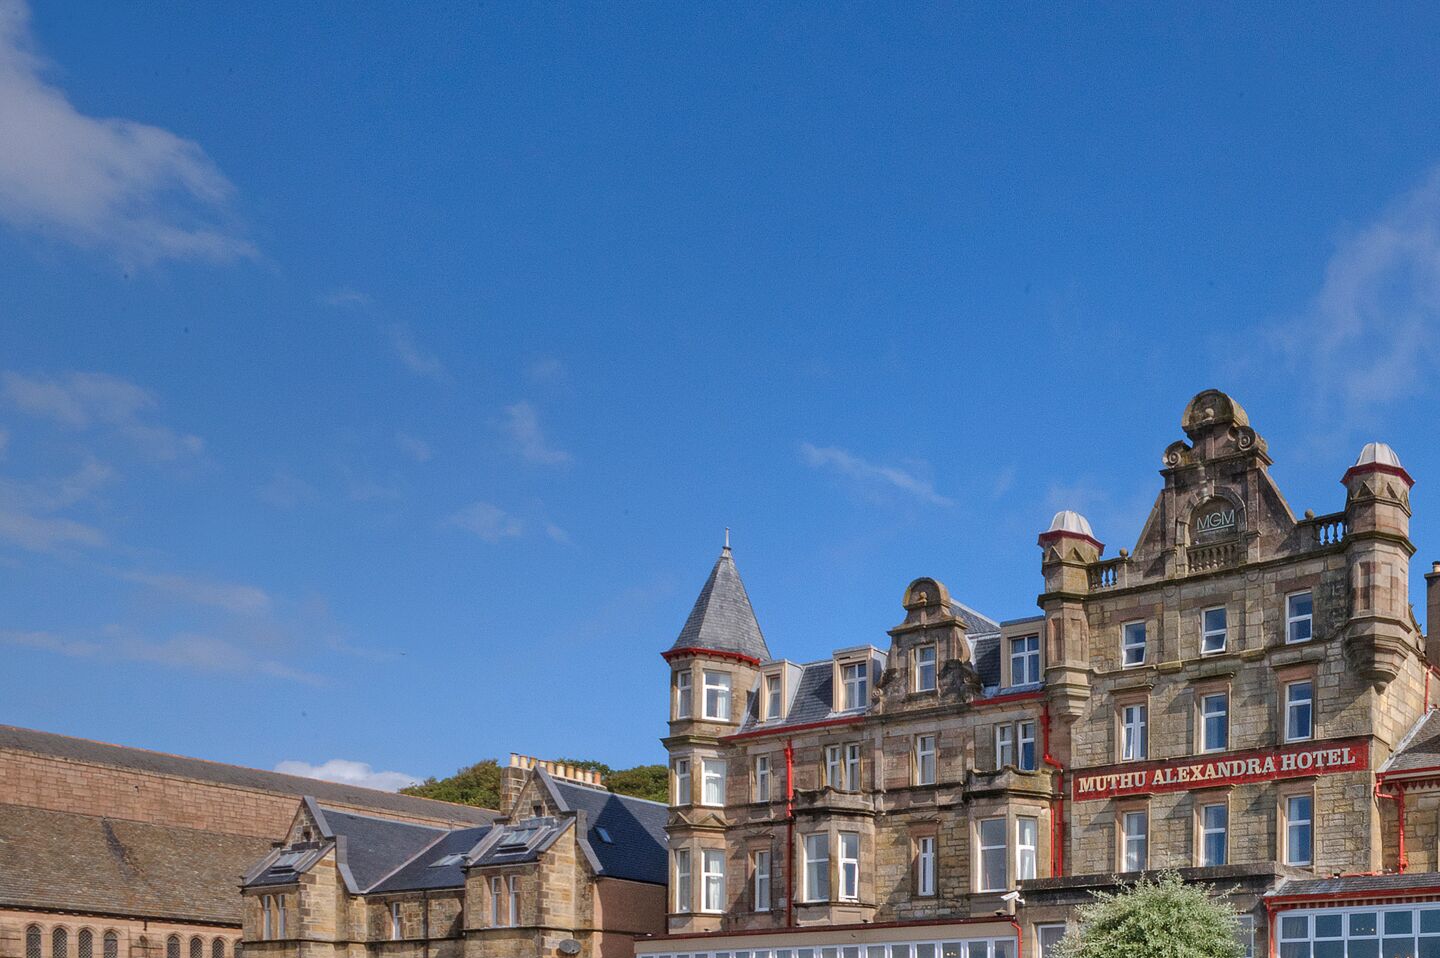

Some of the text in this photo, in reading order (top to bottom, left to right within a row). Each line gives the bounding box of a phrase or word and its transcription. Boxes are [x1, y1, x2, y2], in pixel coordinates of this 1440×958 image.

[1196, 509, 1235, 530] MGM
[1078, 747, 1357, 793] MUTHU ALEXANDRA HOTEL
